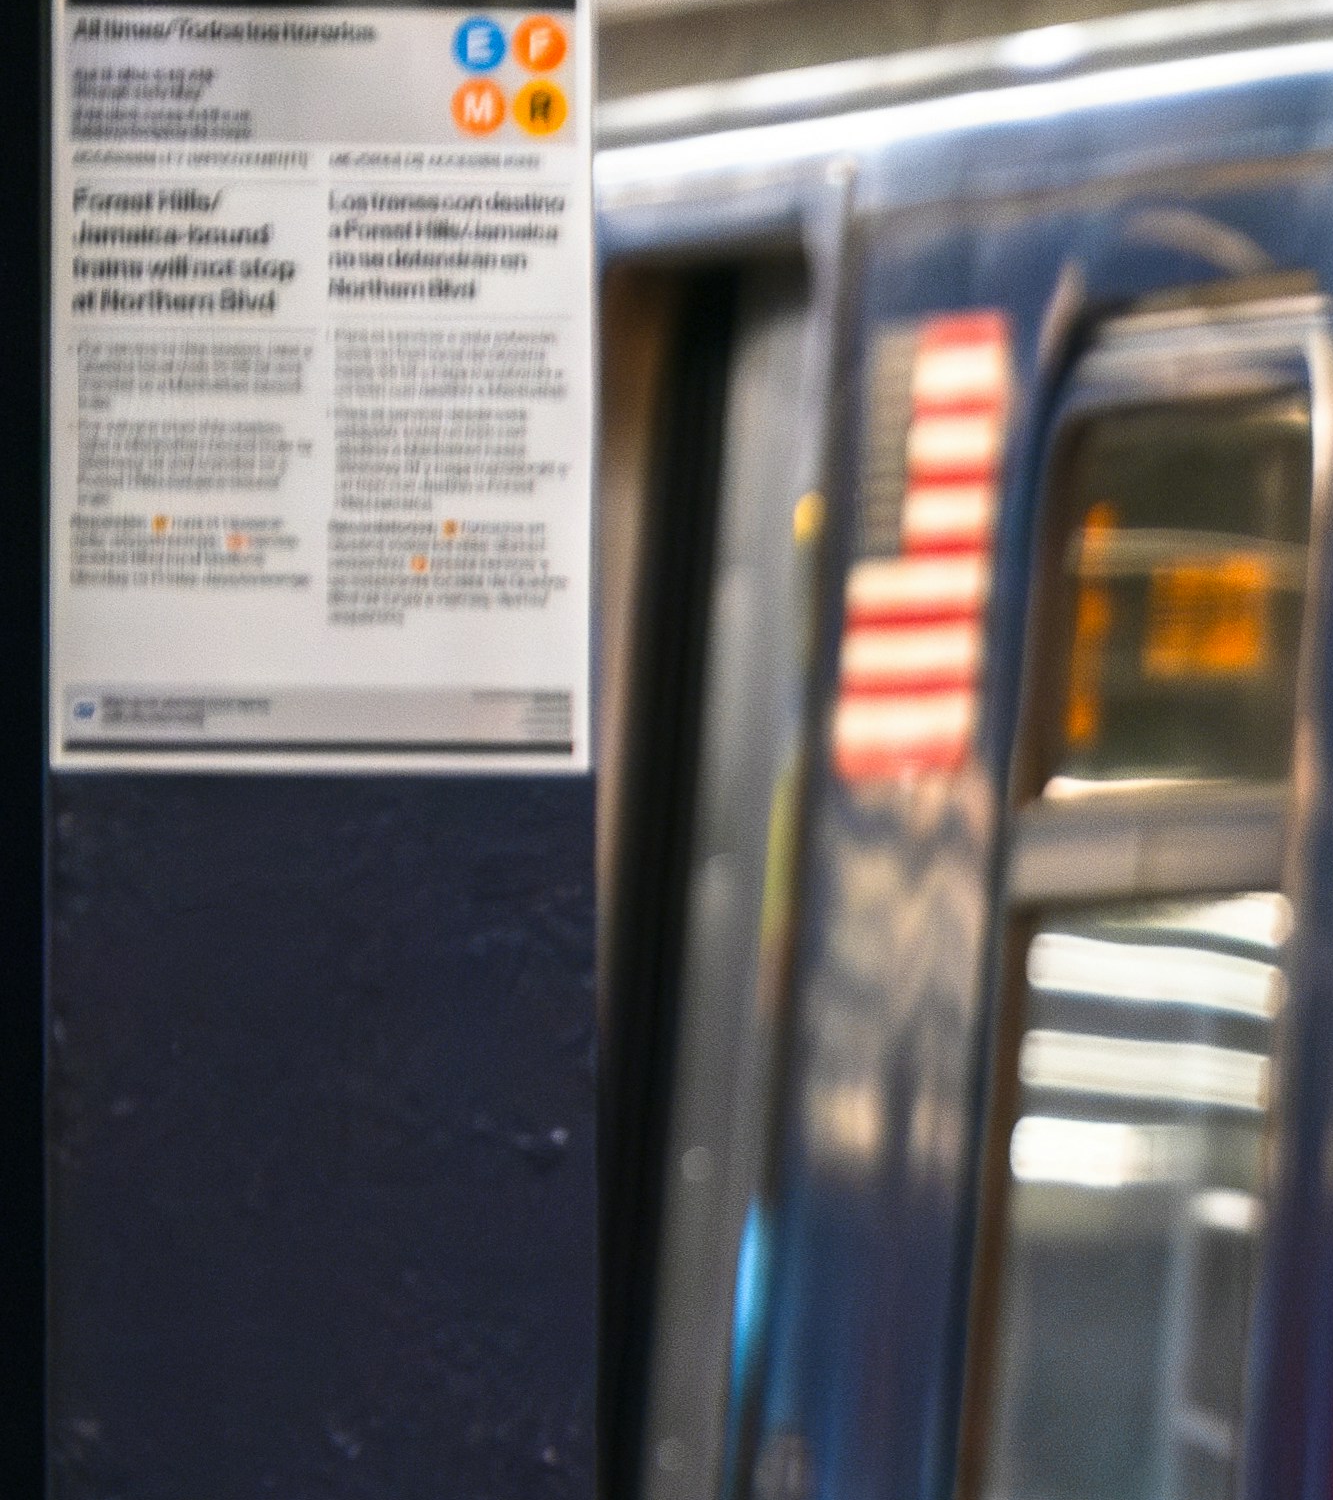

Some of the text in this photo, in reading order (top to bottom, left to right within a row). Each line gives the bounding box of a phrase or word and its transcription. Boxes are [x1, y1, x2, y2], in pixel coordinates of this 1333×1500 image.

[466, 26, 552, 63] E F
[463, 89, 553, 124] M R
[73, 185, 225, 213] Forest Hills/
[73, 255, 297, 284] trains will not stop
[72, 287, 277, 312] at Northern Blvd
[328, 277, 426, 299] Northern
